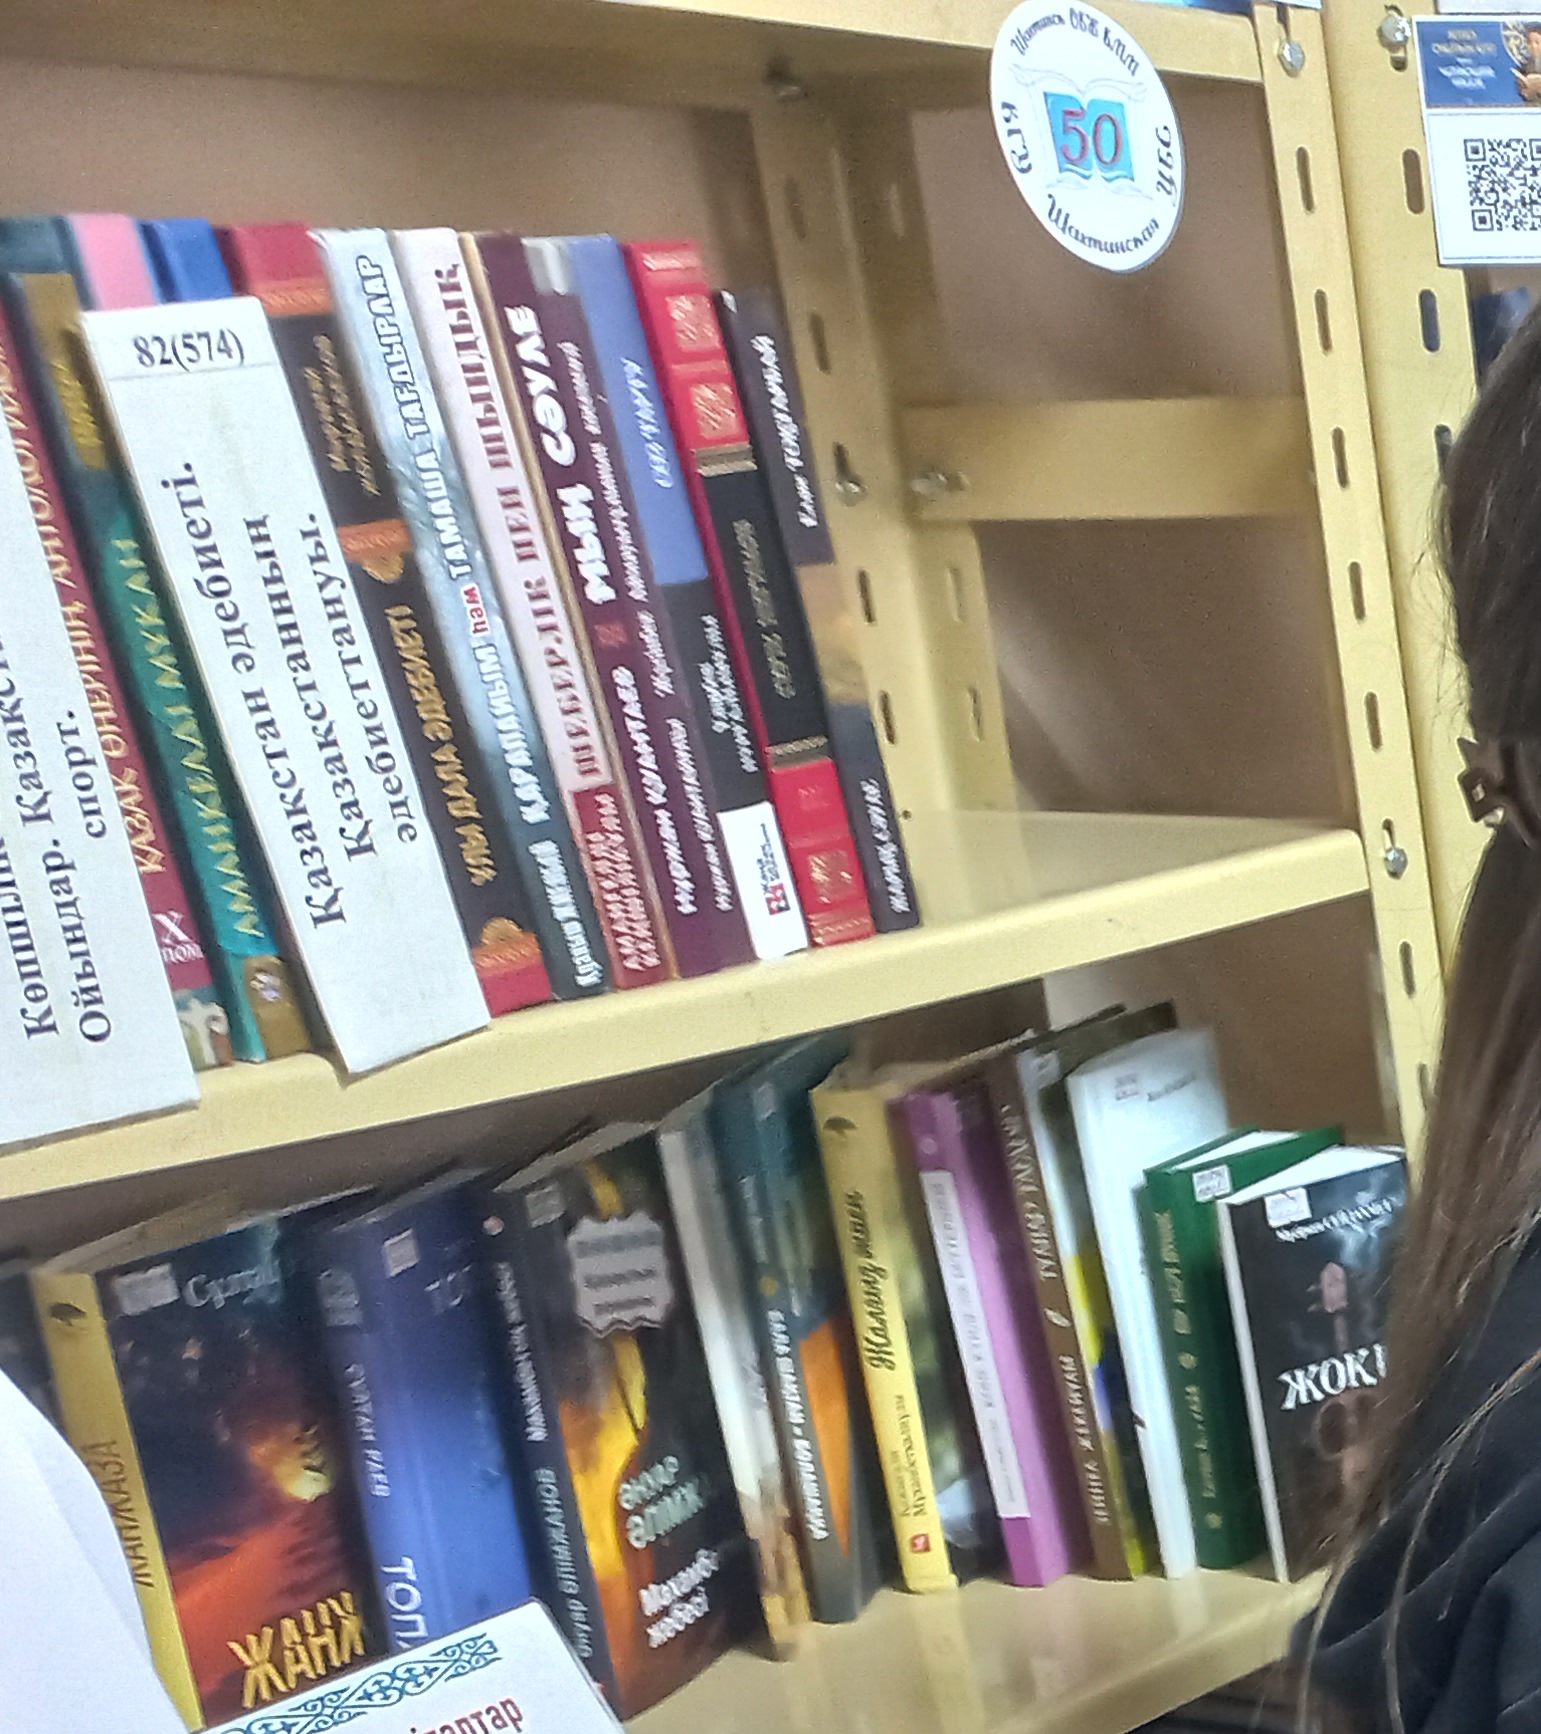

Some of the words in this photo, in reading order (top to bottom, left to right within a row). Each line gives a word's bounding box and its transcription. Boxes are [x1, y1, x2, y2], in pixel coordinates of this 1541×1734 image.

[1061, 108, 1123, 166] 50
[134, 330, 247, 370] 82(574)
[352, 250, 434, 444] ТАҒДЫРЛАР
[503, 297, 578, 473] СӘУЛЕ
[158, 462, 261, 674] әдебиеті.
[415, 449, 475, 582] ТАМАША
[495, 479, 540, 564] ПЕН
[241, 514, 379, 862] Қазақстанның
[295, 508, 424, 844] әдебиеттануы.
[50, 708, 111, 840] спорт.
[240, 684, 347, 931] Қазақстан
[57, 842, 113, 1045] Ойындар.
